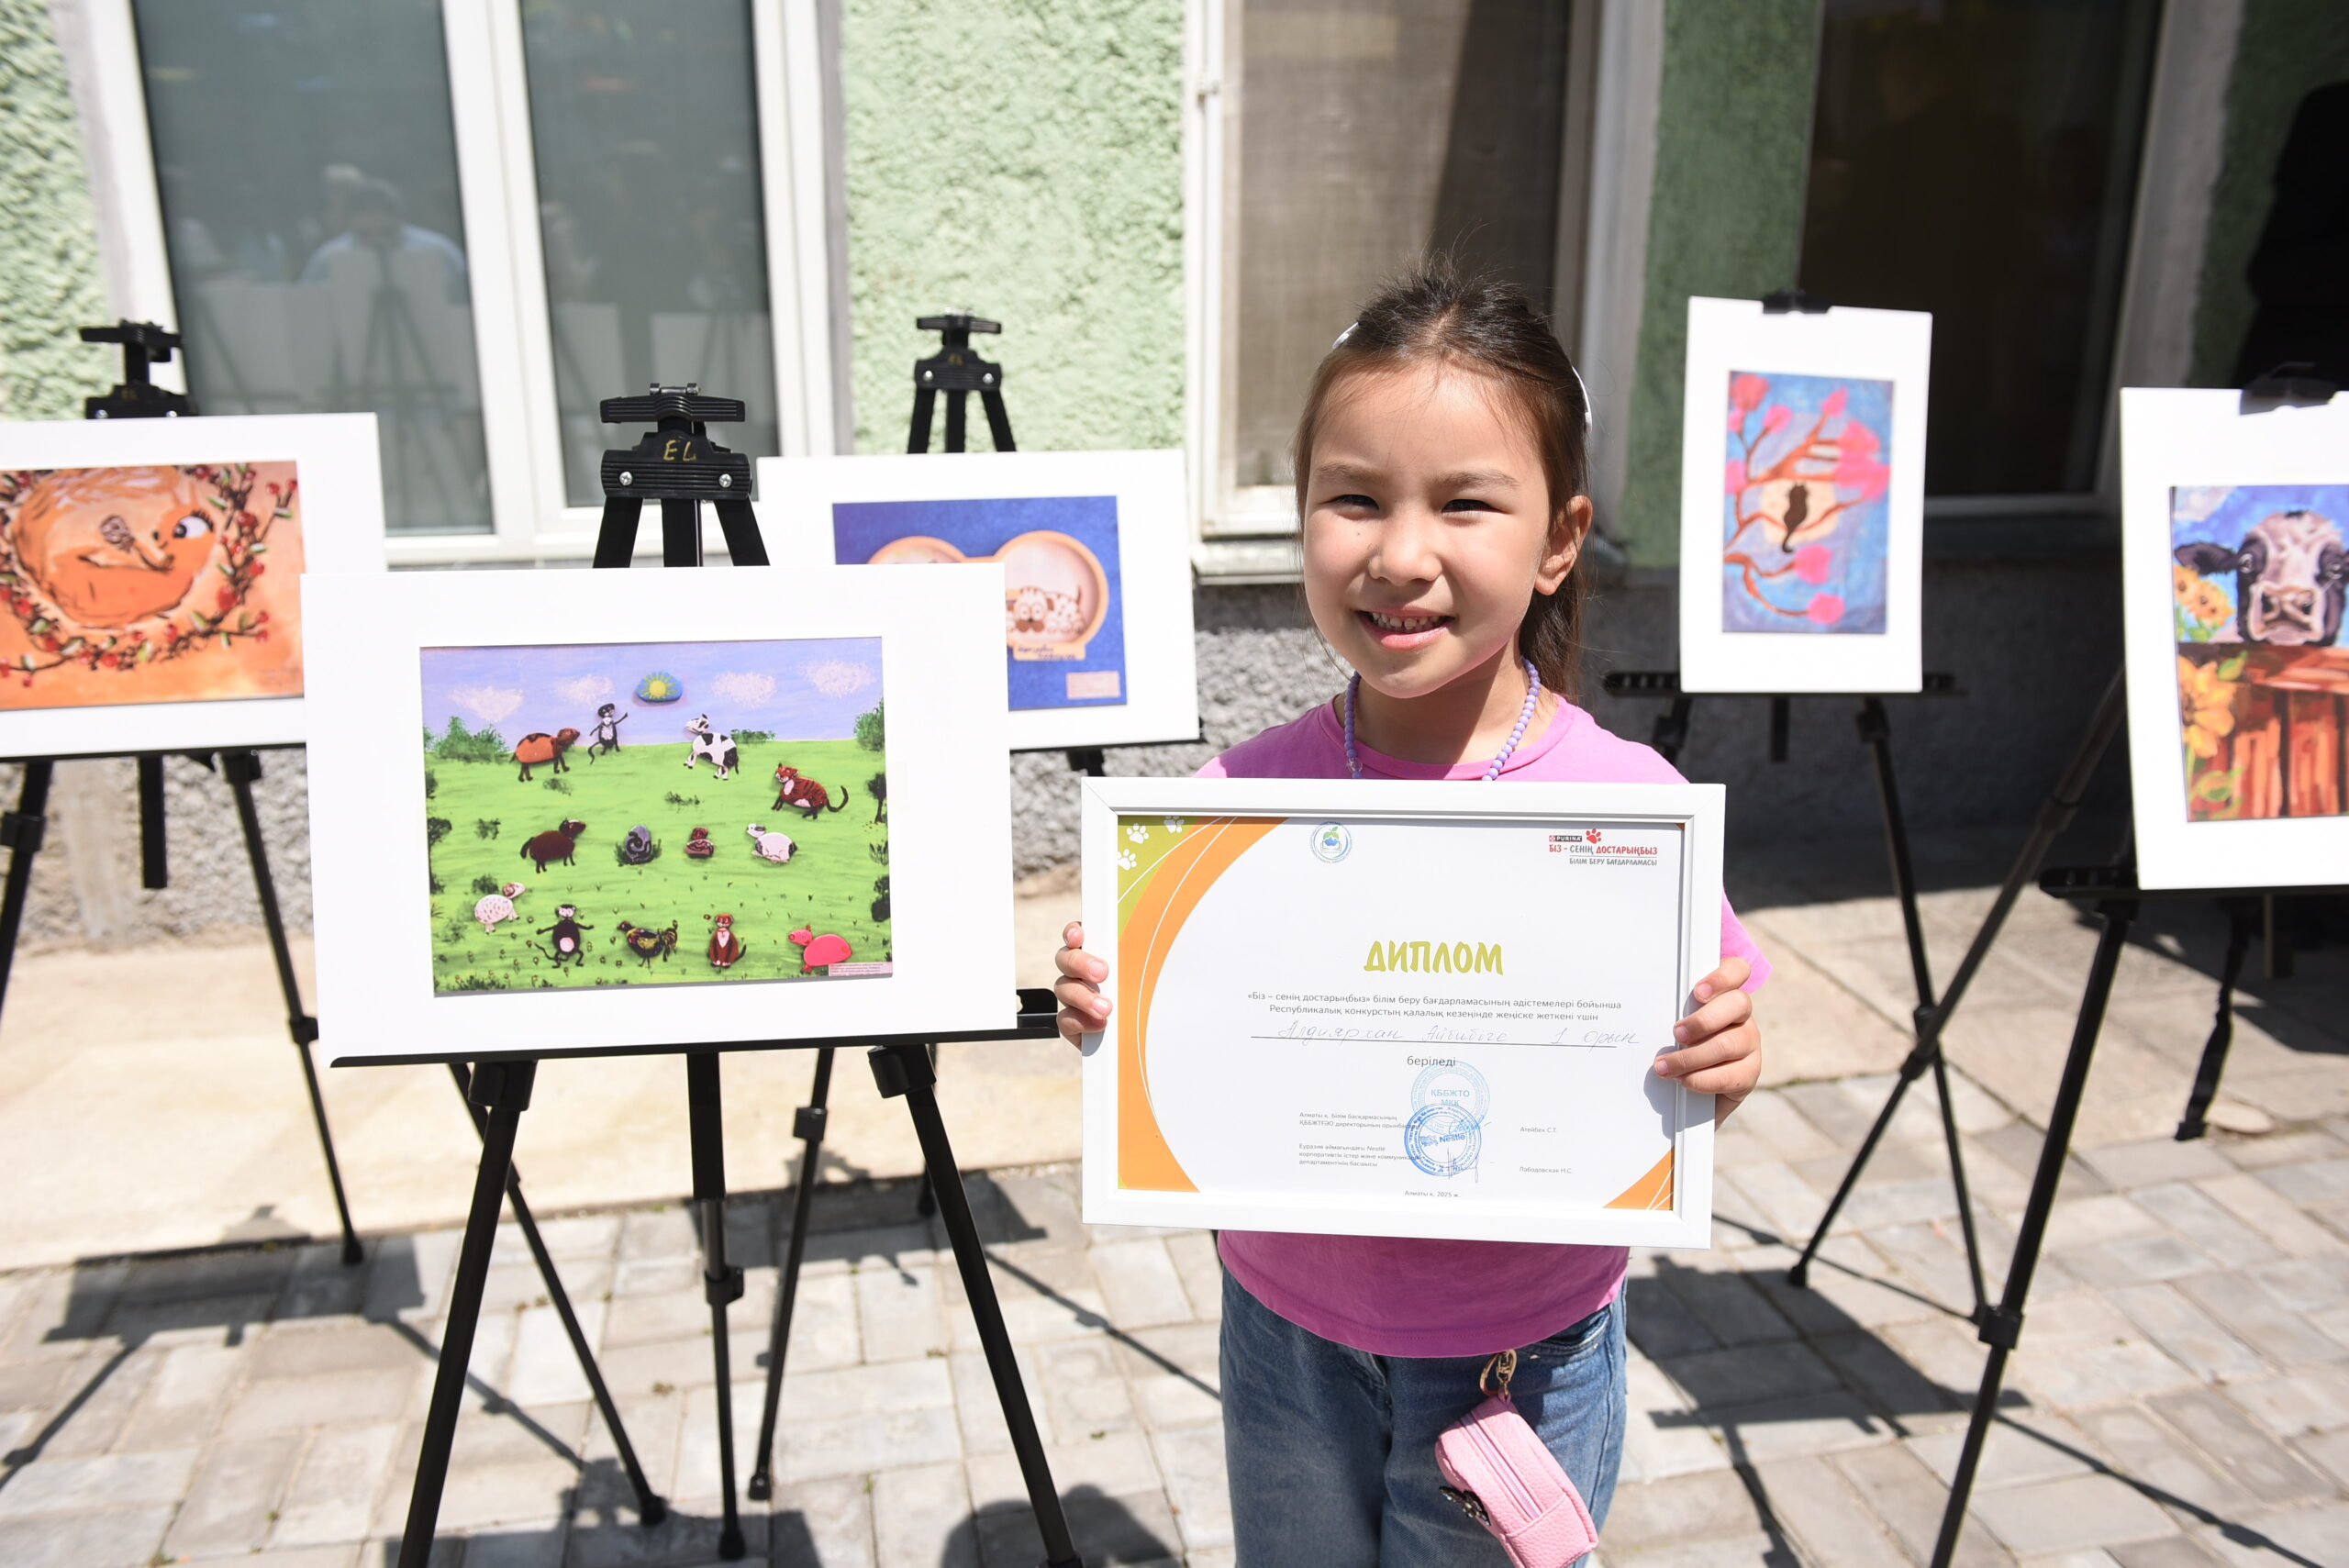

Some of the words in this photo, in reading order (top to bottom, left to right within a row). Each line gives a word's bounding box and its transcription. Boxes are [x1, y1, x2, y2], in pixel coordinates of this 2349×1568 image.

[662, 439, 697, 462] EL
[1549, 844, 1562, 852] БІЗ
[1570, 845, 1594, 855] СЕНІҢ
[1596, 846, 1658, 856] ДОСТАРЫҢБЫЗ
[1364, 940, 1504, 975] ДИПЛОМ
[1248, 991, 1265, 1000] «Біз
[1275, 993, 1300, 1002] сенің
[1302, 994, 1370, 1003] достарыңбыз»
[1373, 995, 1396, 1003] білім
[1398, 995, 1420, 1006] беру
[1422, 996, 1510, 1006] бағдарламасының
[1513, 997, 1574, 1008] әдістемелері
[1576, 999, 1621, 1009] бойынша
[1269, 1004, 1342, 1015] Республикалық
[1344, 1007, 1401, 1017] конкурстың
[1403, 1008, 1444, 1018] қалалық
[1446, 1010, 1494, 1018] кезеңінде
[1496, 1010, 1534, 1019] жеңіске
[1536, 1012, 1574, 1020] жеткені
[1576, 1013, 1598, 1021] үшін
[1407, 1055, 1456, 1068] беріледі
